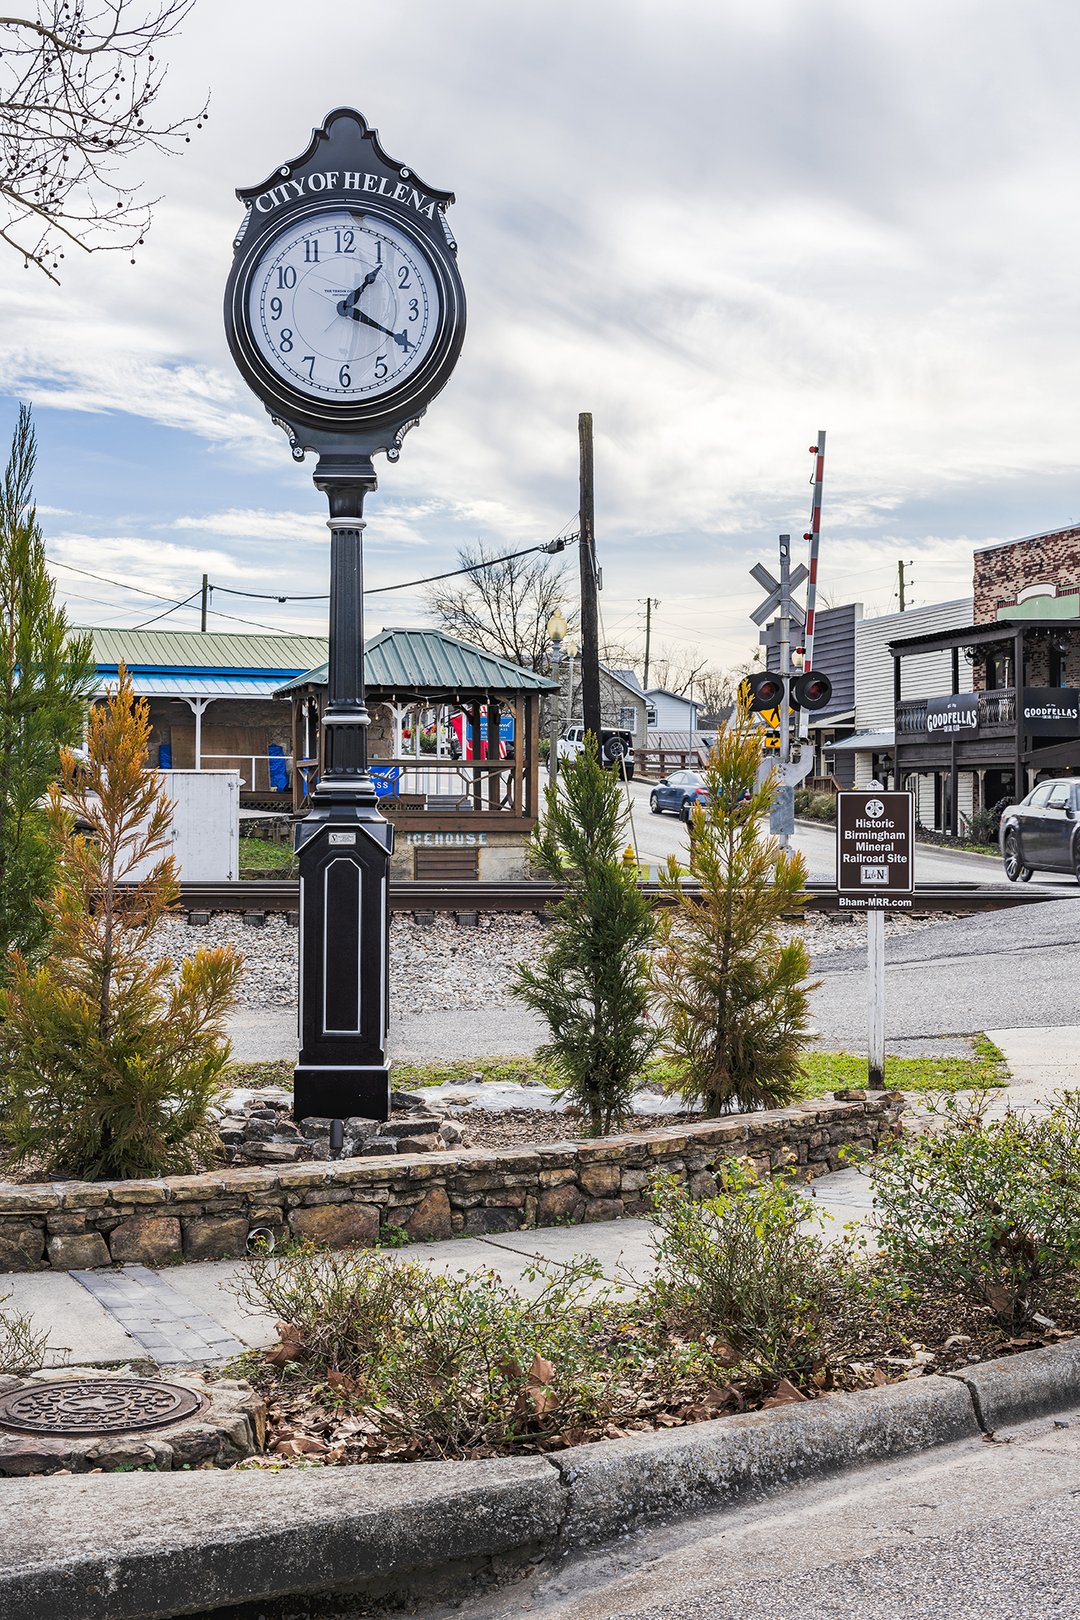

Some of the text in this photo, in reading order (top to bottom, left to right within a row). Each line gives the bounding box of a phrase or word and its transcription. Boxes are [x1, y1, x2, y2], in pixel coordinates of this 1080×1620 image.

[255, 171, 436, 220] CITY OF HELENA
[303, 239, 321, 263] 11
[334, 230, 356, 254] 12
[374, 240, 383, 265] 1
[276, 265, 297, 290] 10
[397, 265, 410, 290] 2
[270, 297, 283, 321] 9
[408, 298, 420, 322] 3
[279, 328, 295, 353] 8
[301, 356, 315, 381] 7
[338, 364, 351, 389] 6
[374, 354, 388, 379] 5
[927, 710, 977, 732] GOODFELLAS
[1024, 707, 1077, 719] GOODFELLAS
[855, 818, 895, 828] Historic
[405, 832, 488, 845] ICEHOUSE
[844, 830, 906, 841] Birmingham
[855, 842, 894, 851] Mineral
[843, 853, 908, 863] Railroad Site
[839, 897, 912, 907] Bham-MRR.com
